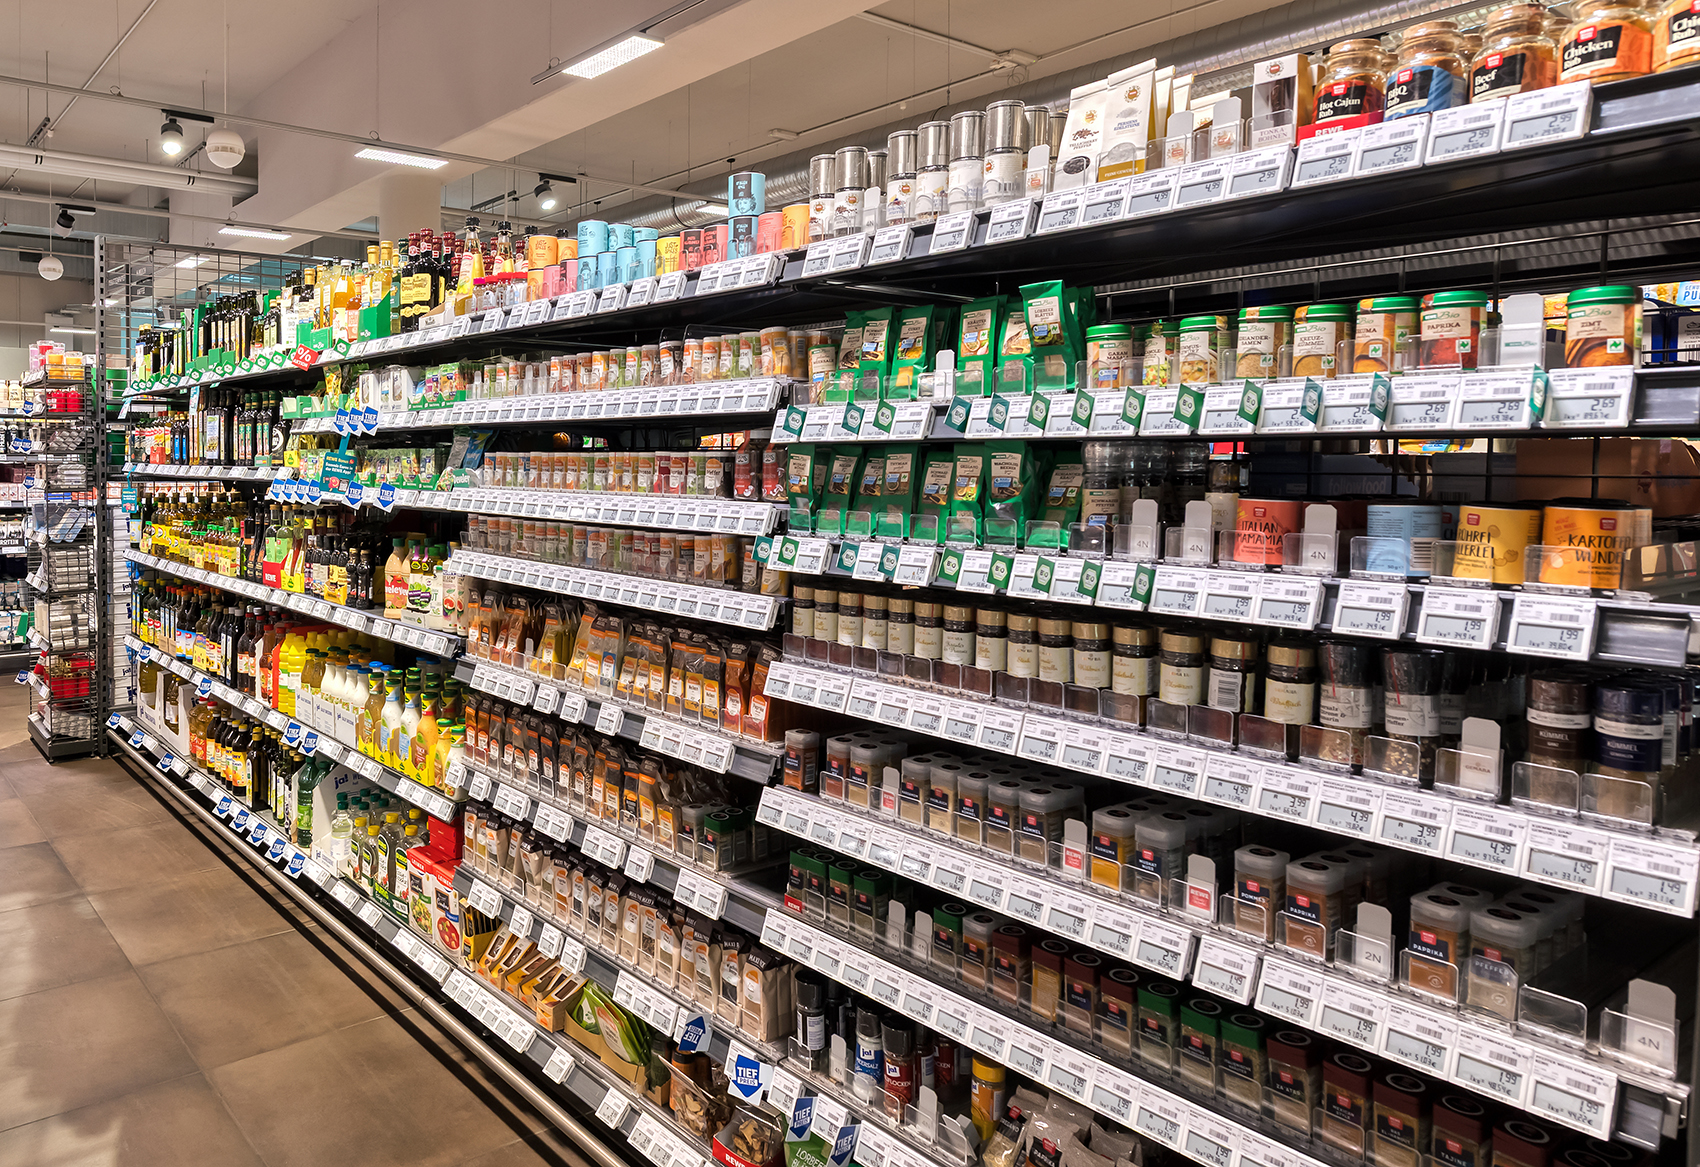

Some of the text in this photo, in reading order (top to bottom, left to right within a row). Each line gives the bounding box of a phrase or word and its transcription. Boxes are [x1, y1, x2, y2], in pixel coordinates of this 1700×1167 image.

[1563, 39, 1614, 61] Chicken
[1563, 56, 1582, 70] Rub
[1474, 69, 1498, 86] Beef
[1387, 85, 1408, 100] BBQ
[1319, 98, 1361, 111] Hot Cajun
[1318, 109, 1333, 119] Rub
[1549, 113, 1573, 128] 2.99
[1257, 132, 1288, 142] BOHNEN
[1258, 125, 1286, 138] TONKA
[1315, 125, 1344, 137] REWE
[1468, 129, 1490, 144] 2.99
[1393, 143, 1413, 158] 2.99
[1329, 157, 1347, 170] 2.99
[1258, 170, 1276, 183] 2.99
[1205, 180, 1221, 193] 4.99
[1154, 191, 1169, 203] 4.99
[1427, 321, 1461, 331] PAPRIKA
[1580, 320, 1603, 329] ZIMT
[1425, 404, 1445, 417] 2.69
[1498, 401, 1519, 415] 2.69
[1591, 399, 1616, 412] 2.69
[1241, 520, 1278, 533] ITALIAN
[1136, 539, 1150, 549] 4N
[1189, 543, 1204, 553] 4N
[1310, 550, 1327, 560] 4N
[264, 572, 277, 583] REWE
[1183, 593, 1195, 603] 1.99
[1235, 598, 1249, 608] 1.99
[1292, 603, 1307, 615] 1.99
[1375, 611, 1392, 624] 1.99
[1464, 620, 1482, 633] 1.99
[1559, 629, 1579, 643] 1.99
[1539, 729, 1570, 741] KÜMMEL
[1606, 739, 1639, 752] KÜMMEL
[333, 771, 349, 790] ja!
[1232, 784, 1249, 797] 4.99
[1289, 796, 1307, 809] 3.99
[1350, 810, 1370, 824] 4.39
[1417, 825, 1437, 840] 3.99
[1065, 849, 1082, 860] REWE
[1490, 841, 1512, 856] 4.39
[410, 856, 426, 872] LEIMER
[1573, 861, 1593, 875] 1.49
[1189, 888, 1210, 900] REWE
[1660, 880, 1681, 895] 1.49
[1240, 891, 1266, 904] POMMES
[787, 900, 801, 912] REWE
[1030, 902, 1042, 913] 1.99
[1289, 906, 1317, 920] PAPRIKA
[1072, 917, 1085, 929] 1.99
[1116, 931, 1130, 944] 1.99
[1162, 949, 1179, 963] 2.49
[1412, 943, 1444, 958] PAPRIKA
[1364, 951, 1382, 964] 2N
[1229, 973, 1244, 986] 1.49
[1294, 996, 1310, 1010] 1.99
[1357, 1020, 1374, 1034] 1.99
[682, 1031, 700, 1044] TIEF
[1637, 1036, 1661, 1050] 4N
[1425, 1043, 1443, 1058] 1.99
[737, 1066, 758, 1079] TIEF
[1498, 1070, 1518, 1086] 1.99
[737, 1077, 759, 1087] PREIS
[1117, 1097, 1130, 1110] 1.99
[1579, 1099, 1599, 1115] 1.99
[794, 1106, 811, 1119] TIEF
[1164, 1120, 1178, 1134] 1.99
[836, 1134, 854, 1148] TIEF
[1215, 1144, 1229, 1158] 1.99
